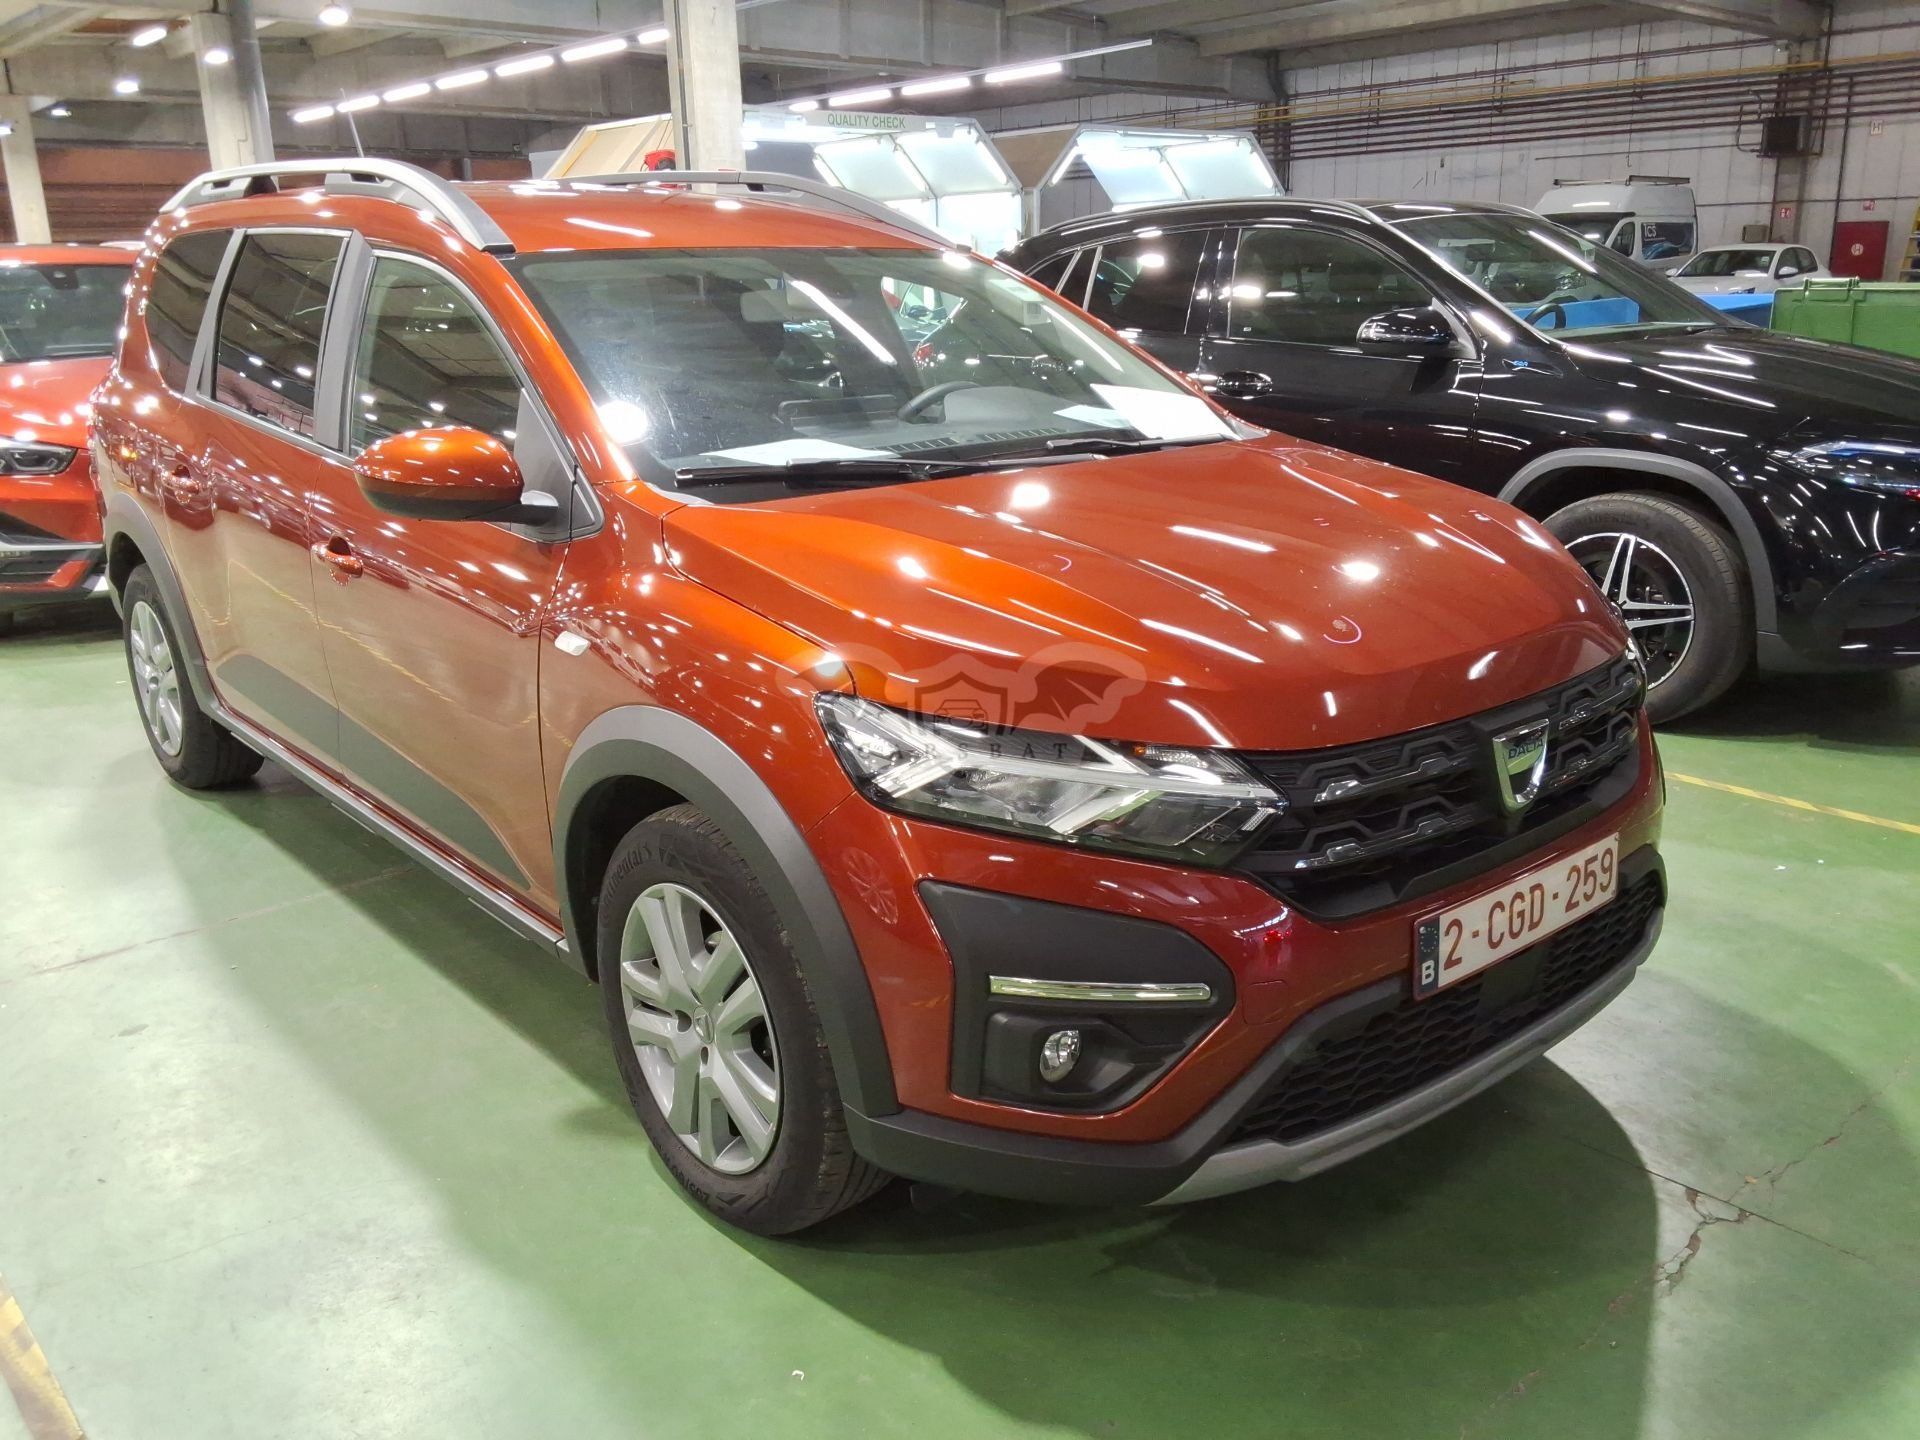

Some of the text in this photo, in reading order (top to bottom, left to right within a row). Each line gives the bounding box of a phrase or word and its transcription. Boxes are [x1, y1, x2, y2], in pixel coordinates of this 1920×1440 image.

[828, 113, 906, 128] QUALITY CHECK
[1443, 847, 1613, 971] 2-CGD-259
[1421, 960, 1435, 986] B
